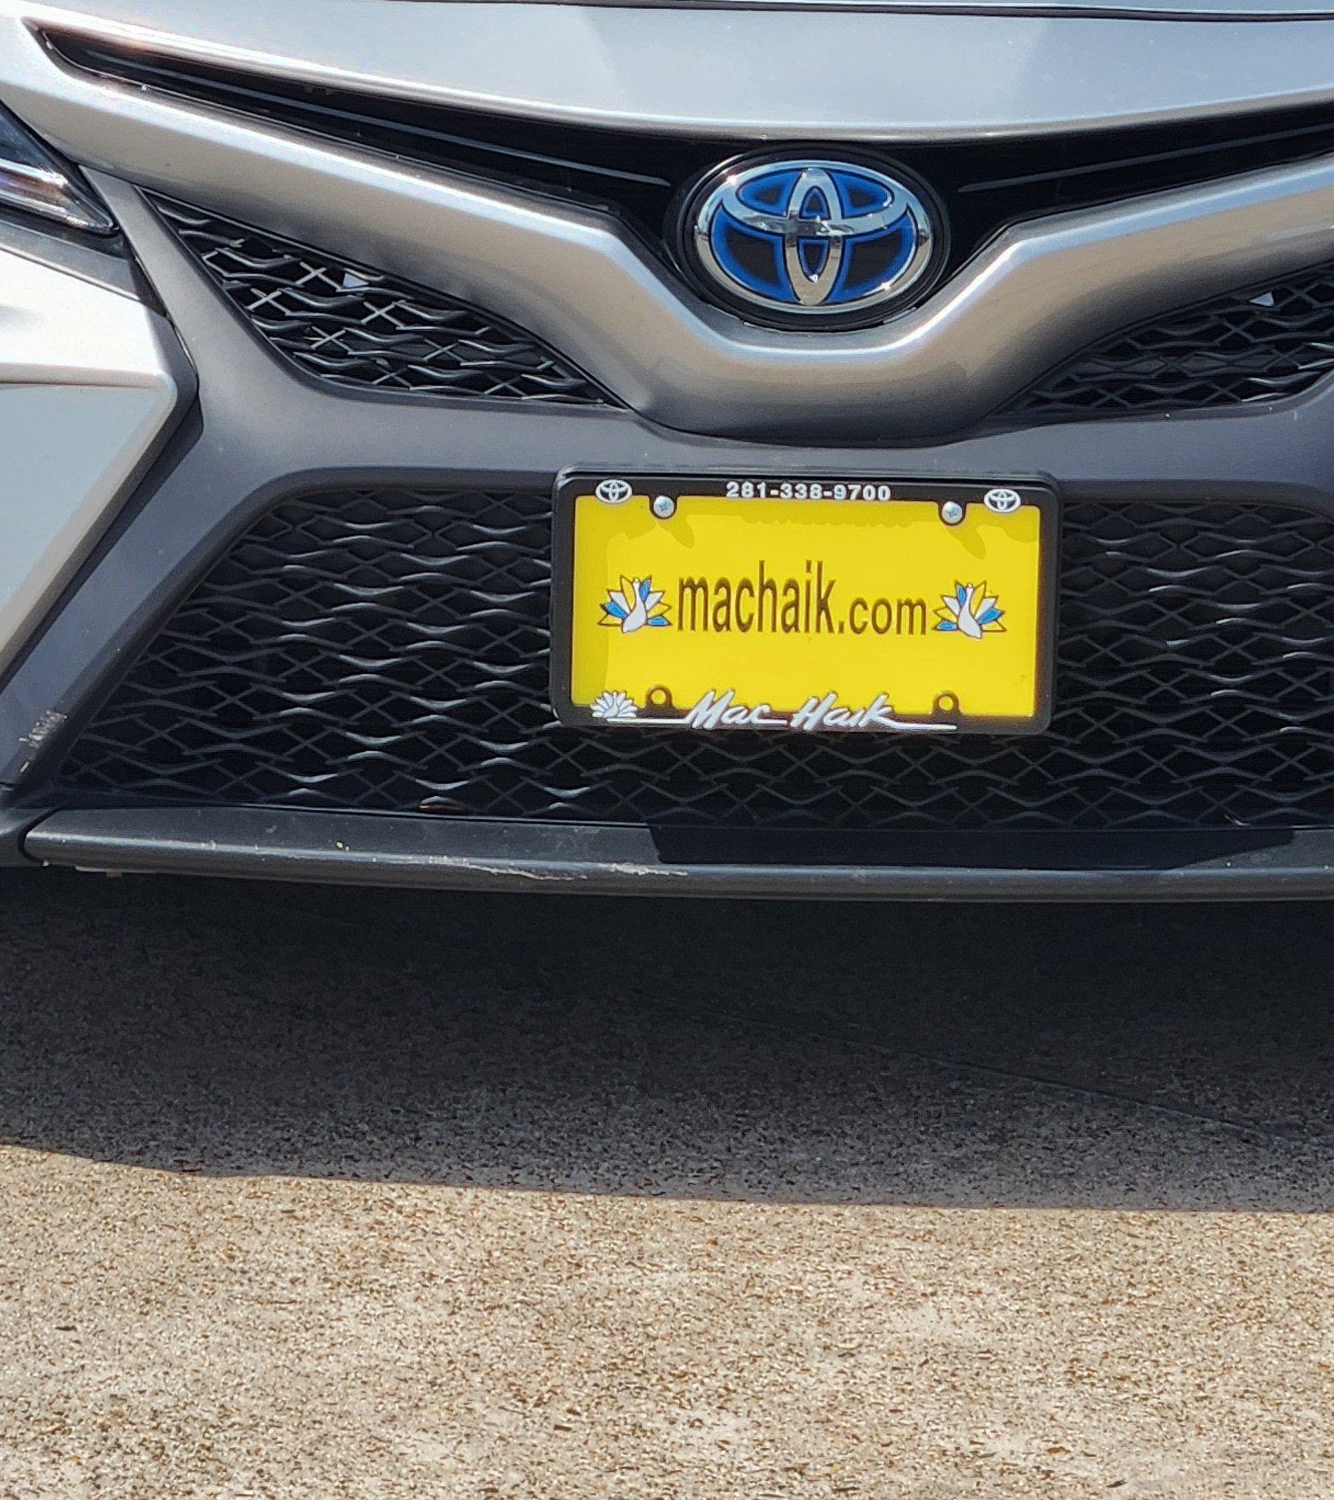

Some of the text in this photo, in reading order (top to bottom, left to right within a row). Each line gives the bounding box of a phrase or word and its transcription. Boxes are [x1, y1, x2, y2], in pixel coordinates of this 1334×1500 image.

[725, 481, 892, 502] 281-338-9700
[677, 559, 928, 636] machaik.com
[681, 689, 909, 731] Mac Haik
